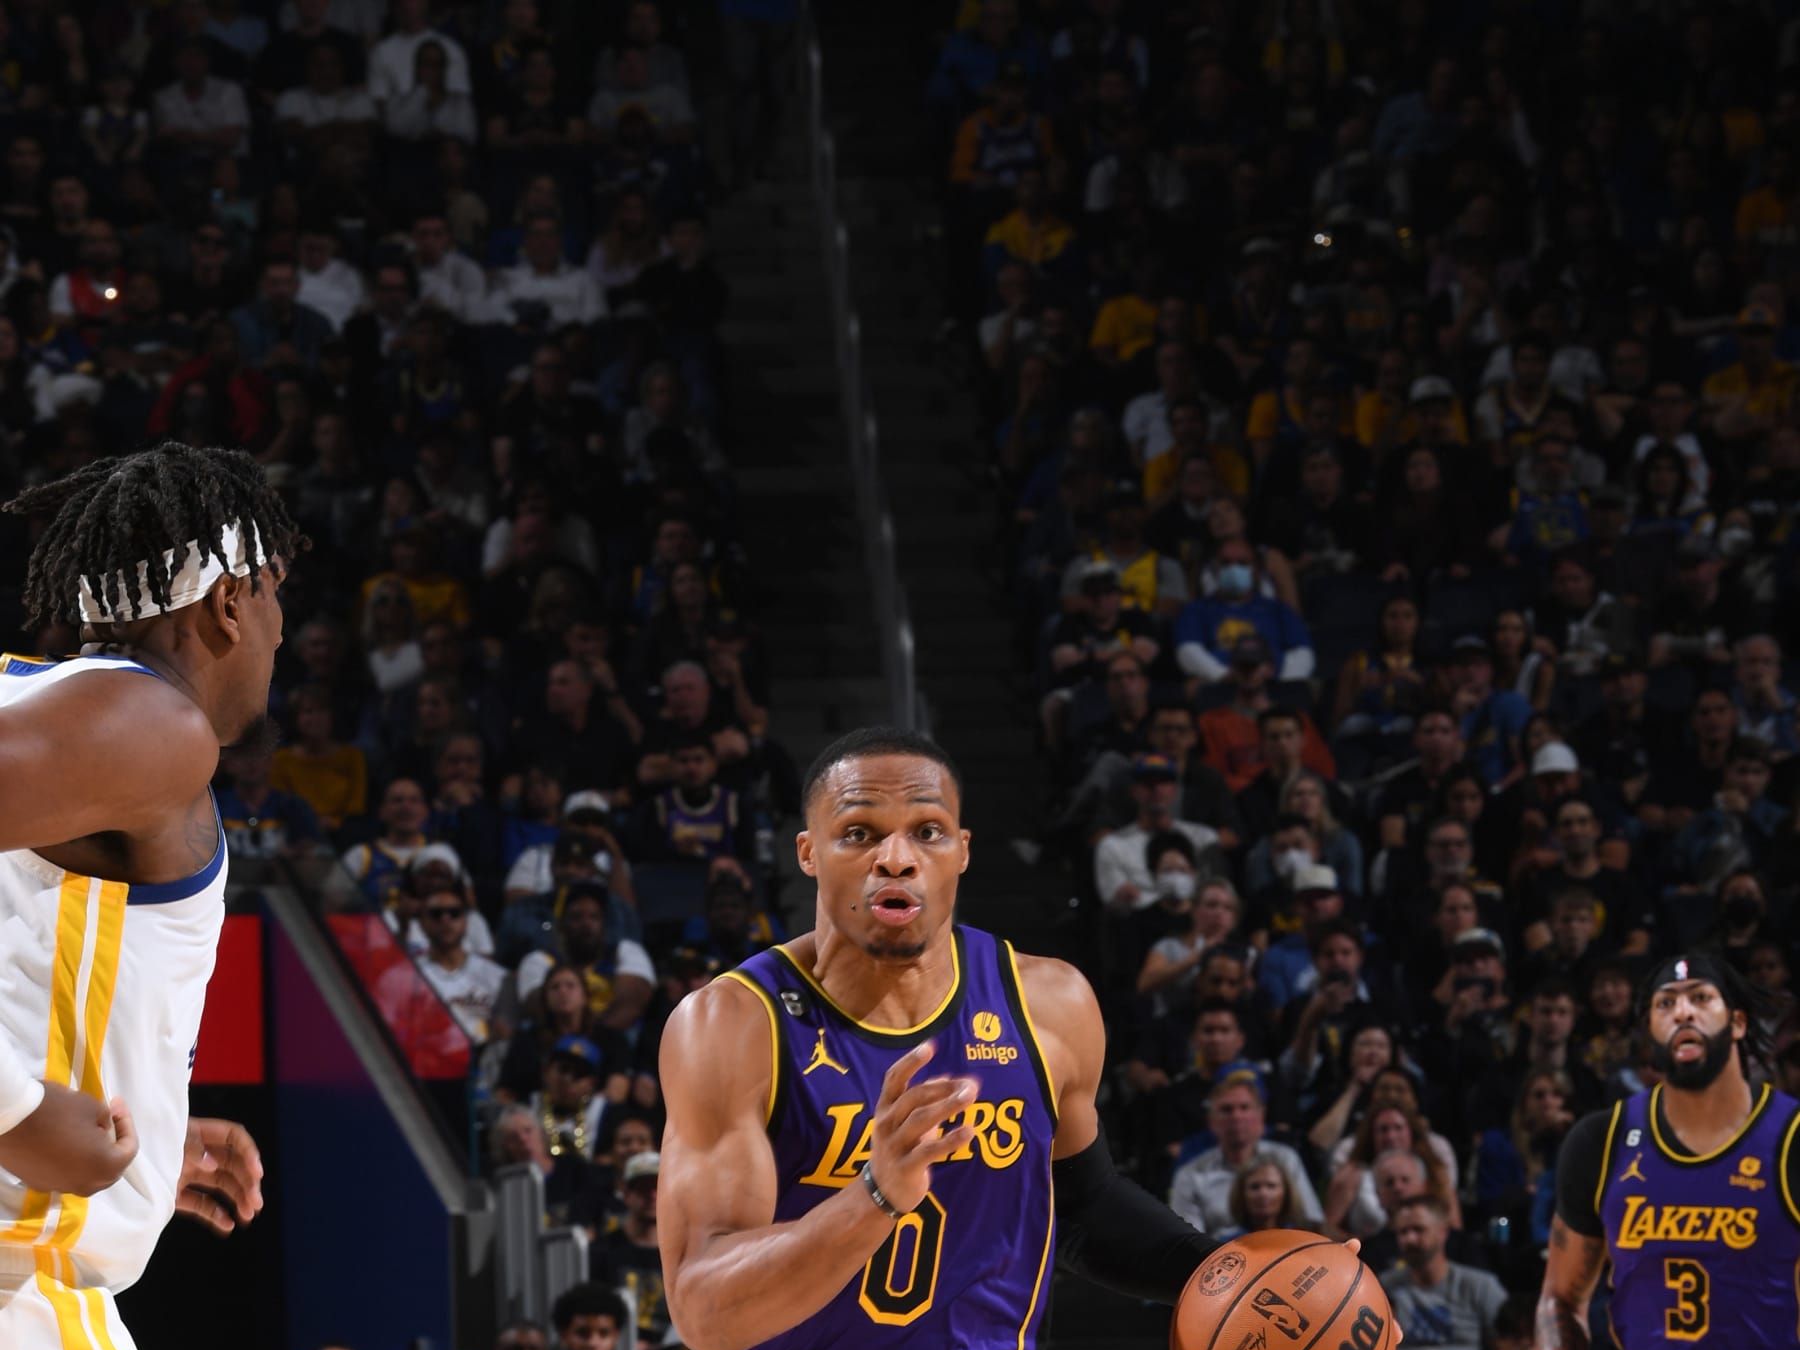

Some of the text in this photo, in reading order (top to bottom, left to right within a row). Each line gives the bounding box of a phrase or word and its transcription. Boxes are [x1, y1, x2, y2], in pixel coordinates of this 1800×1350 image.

[965, 1043, 1018, 1065] bibigo
[1625, 1128, 1642, 1147] 6
[1615, 1195, 1759, 1250] LAKERS
[858, 1190, 947, 1327] 0
[1664, 1257, 1711, 1343] 3
